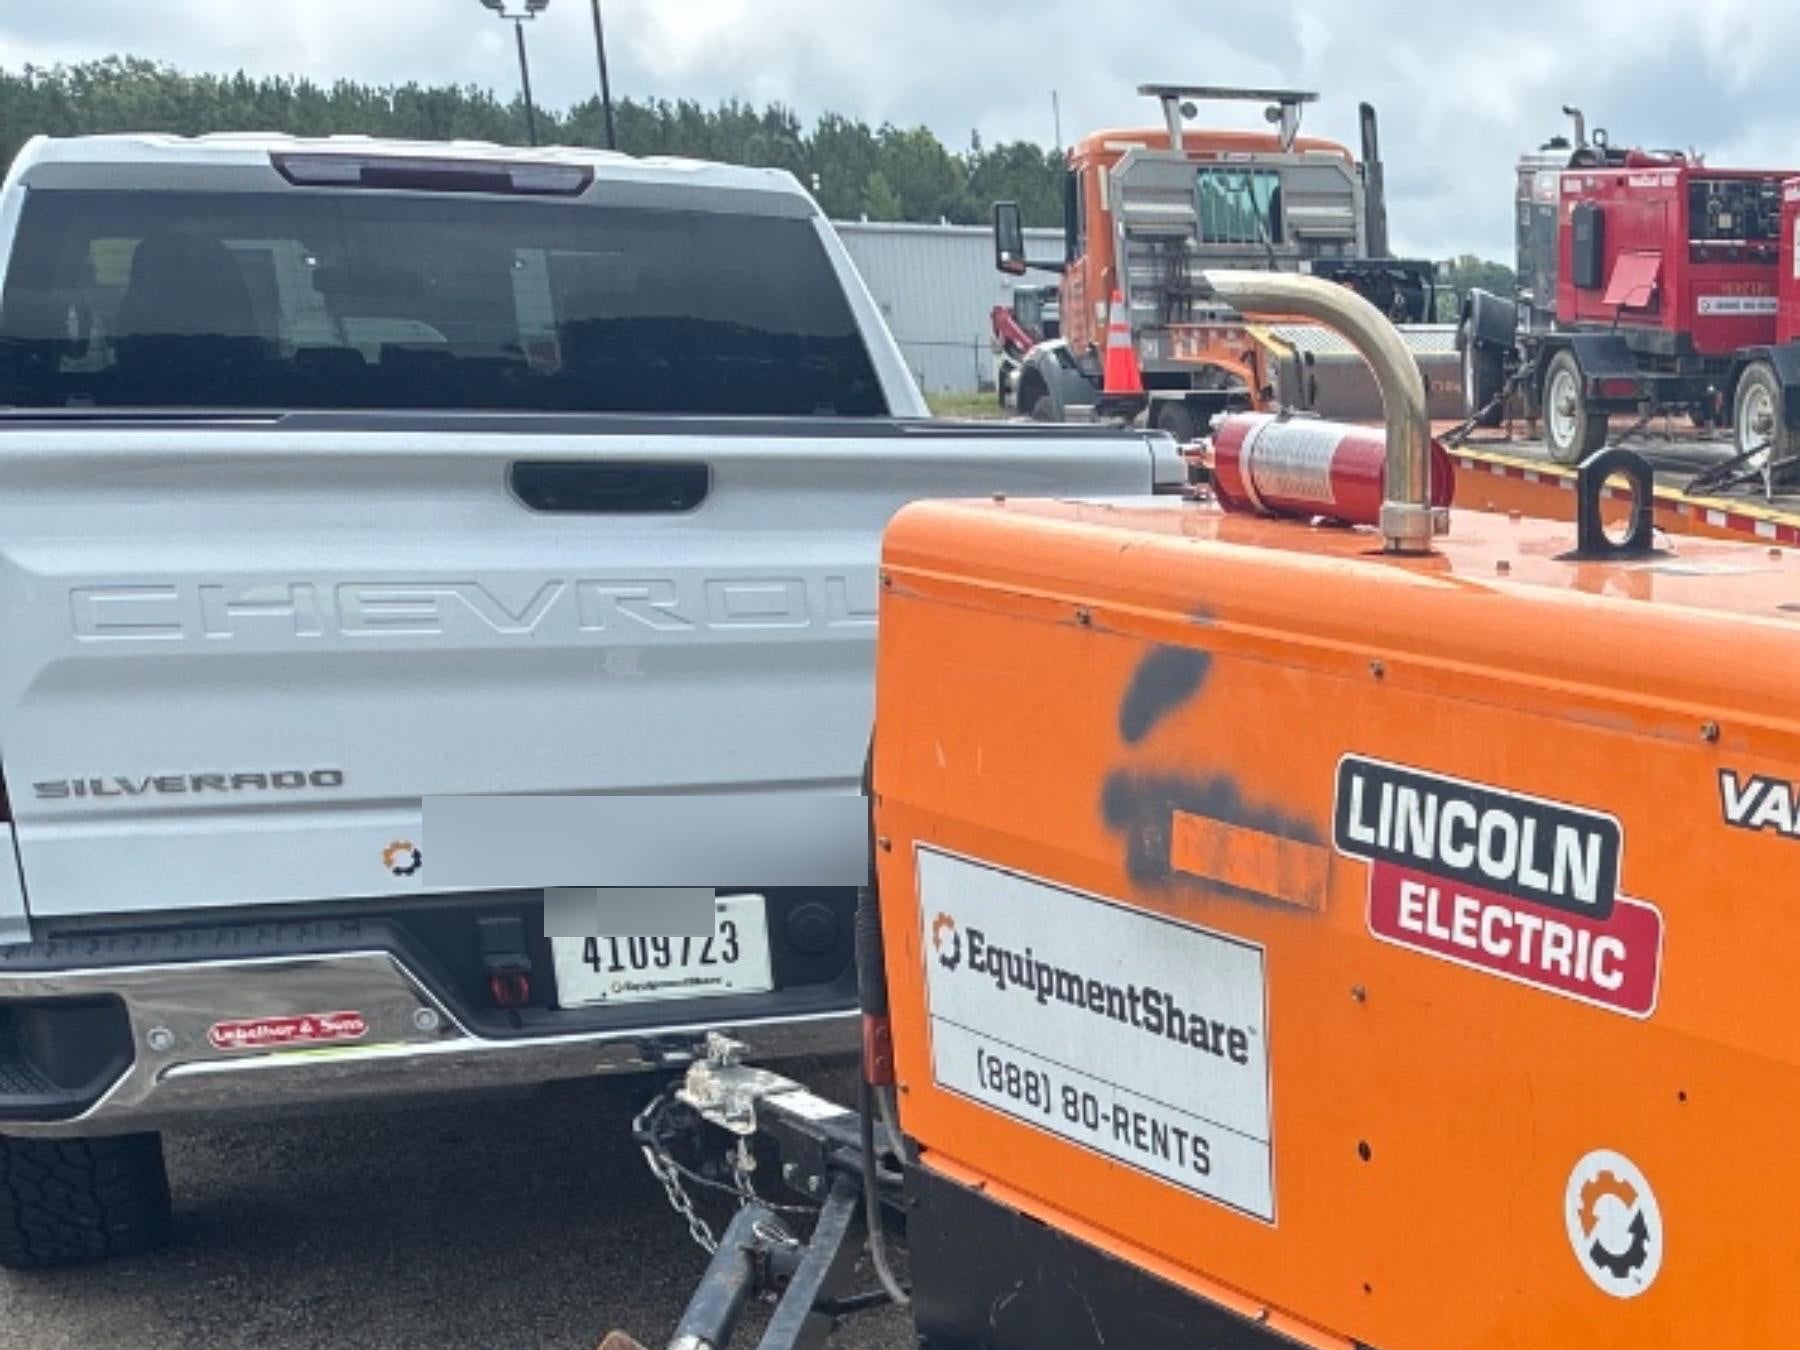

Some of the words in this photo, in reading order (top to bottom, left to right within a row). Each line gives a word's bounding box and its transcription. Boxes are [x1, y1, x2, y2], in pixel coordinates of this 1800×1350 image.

[33, 769, 345, 800] SILVERADO
[1347, 775, 1602, 903] LINCOLN
[966, 927, 1249, 1066] EquipmentShare
[1399, 880, 1627, 990] ELECTRIC
[977, 1047, 1052, 1114] (888)
[1061, 1085, 1211, 1176] 80-RENTS
